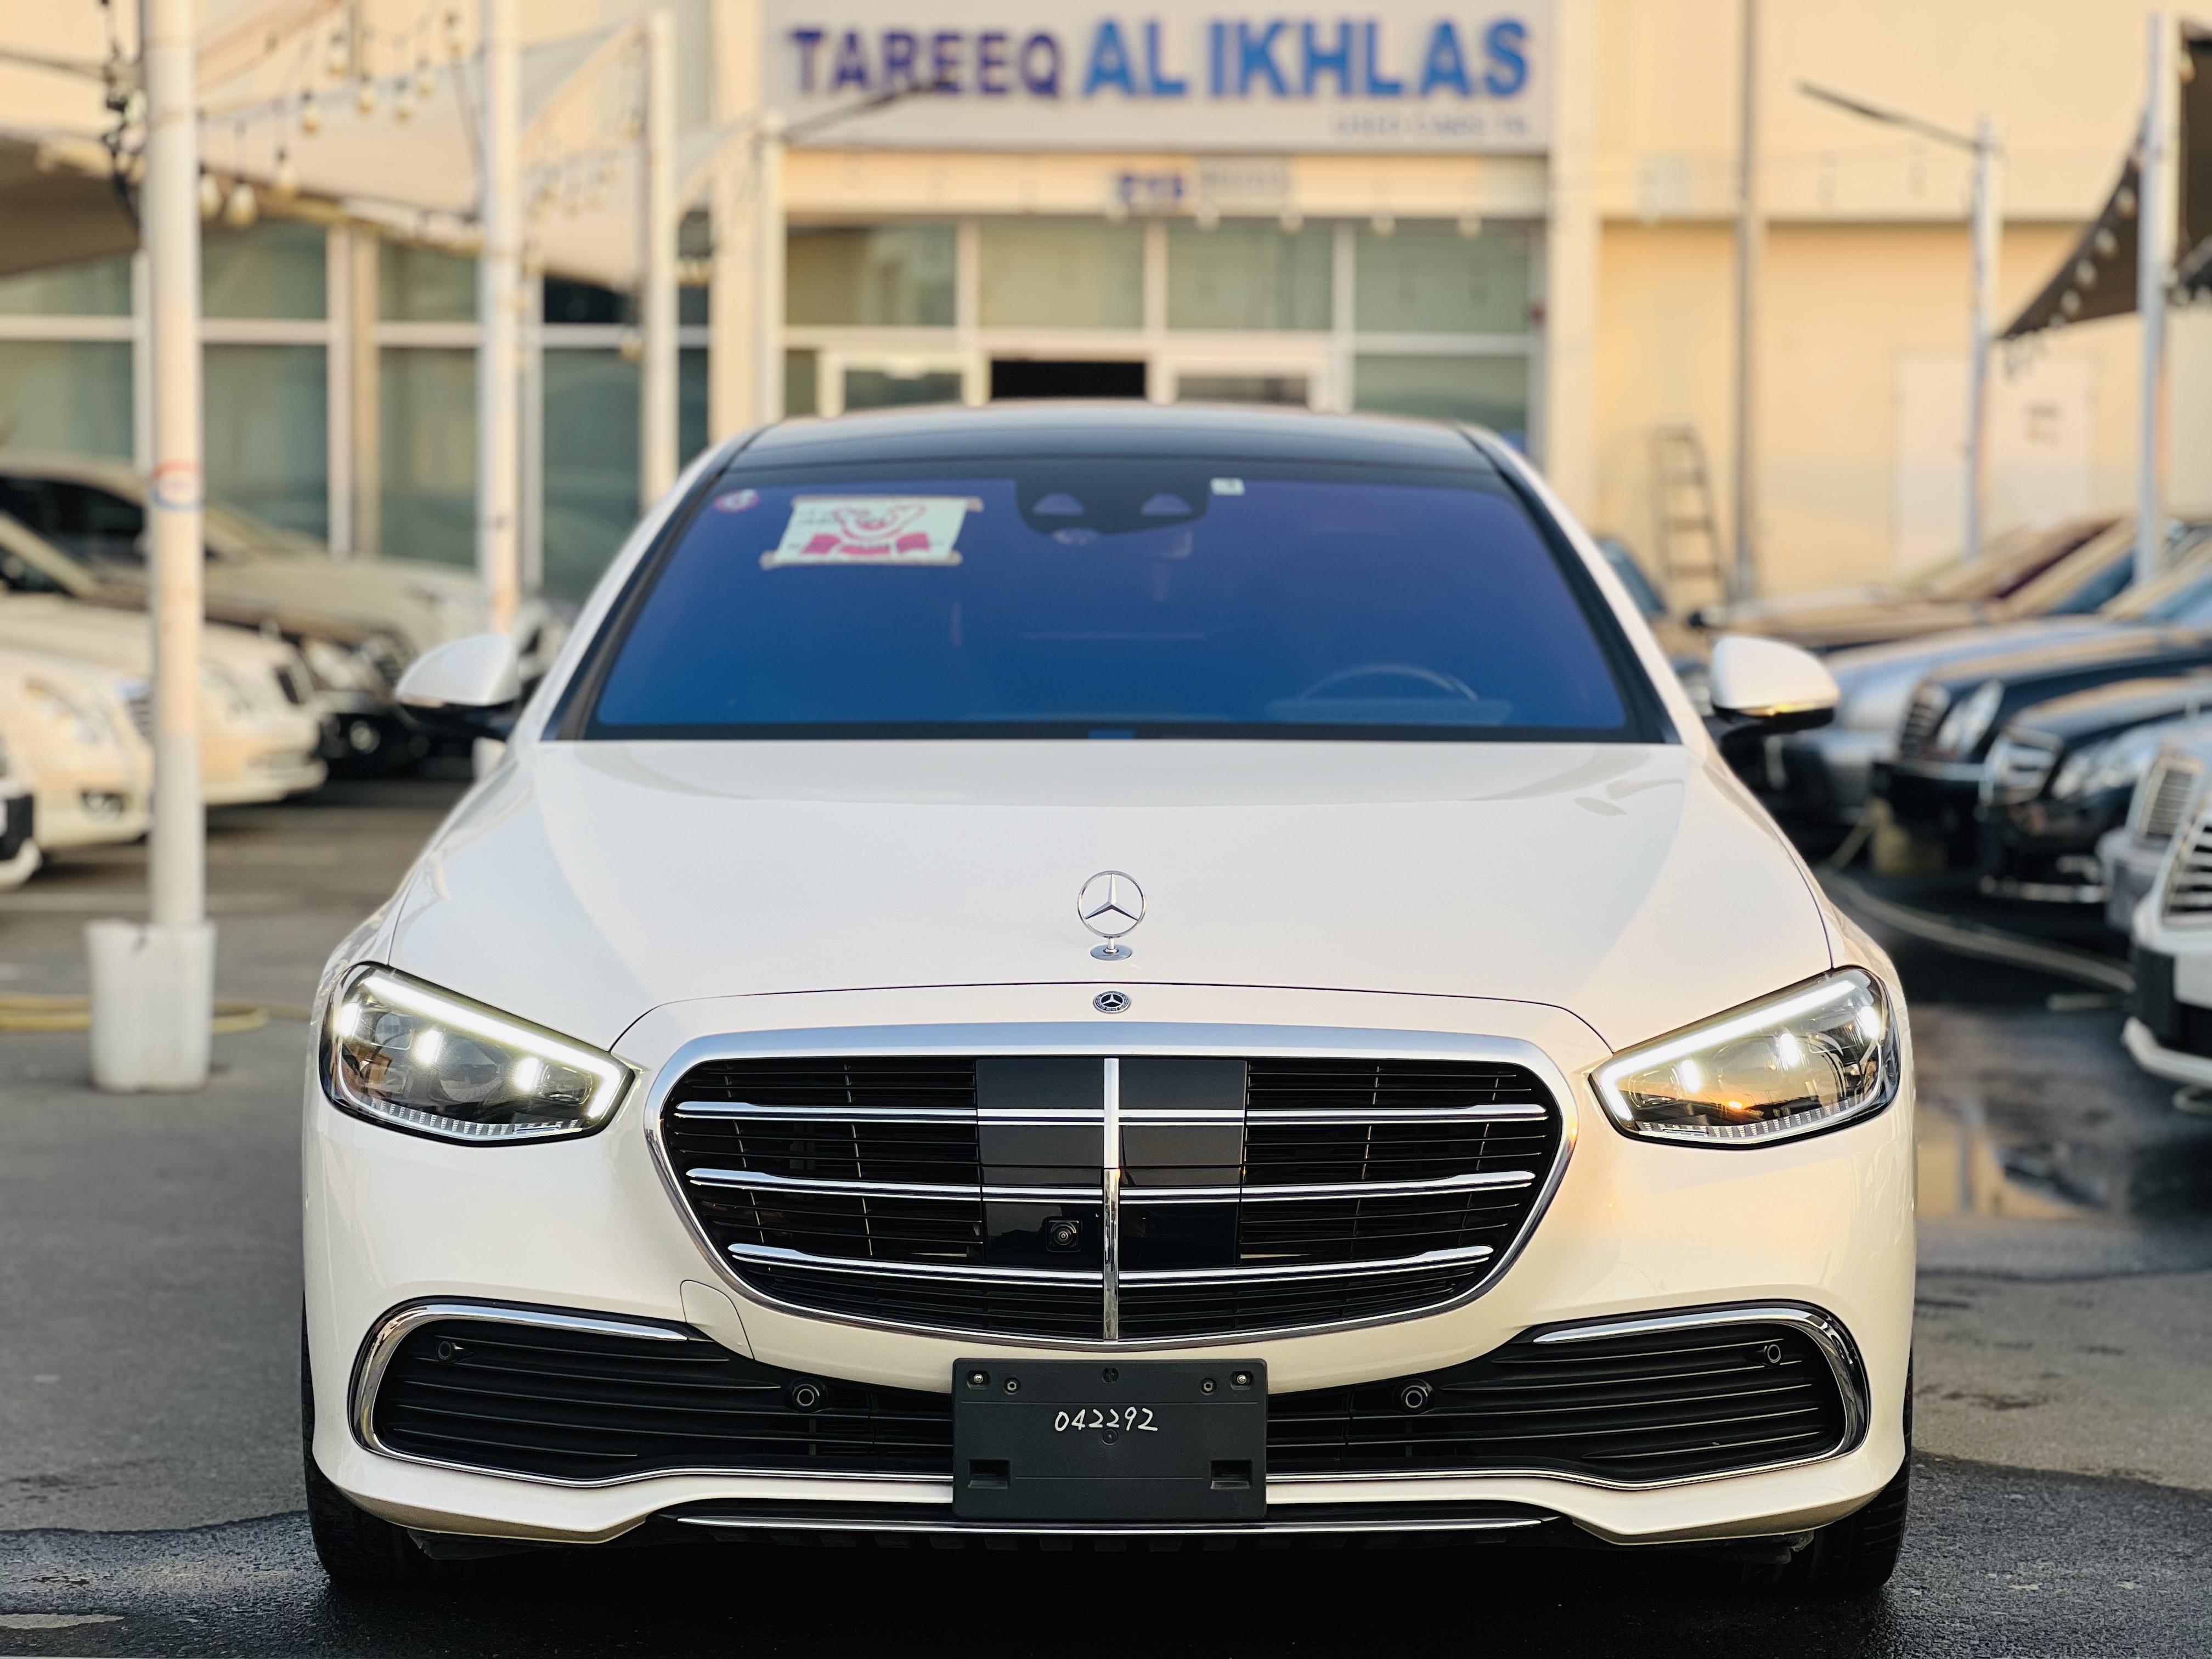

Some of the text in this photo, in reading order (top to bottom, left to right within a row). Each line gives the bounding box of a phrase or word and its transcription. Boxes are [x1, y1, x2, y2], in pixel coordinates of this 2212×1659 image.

[789, 19, 1530, 98] TAREEQ AL IKHLAS
[1054, 1406, 1158, 1432] 042292
